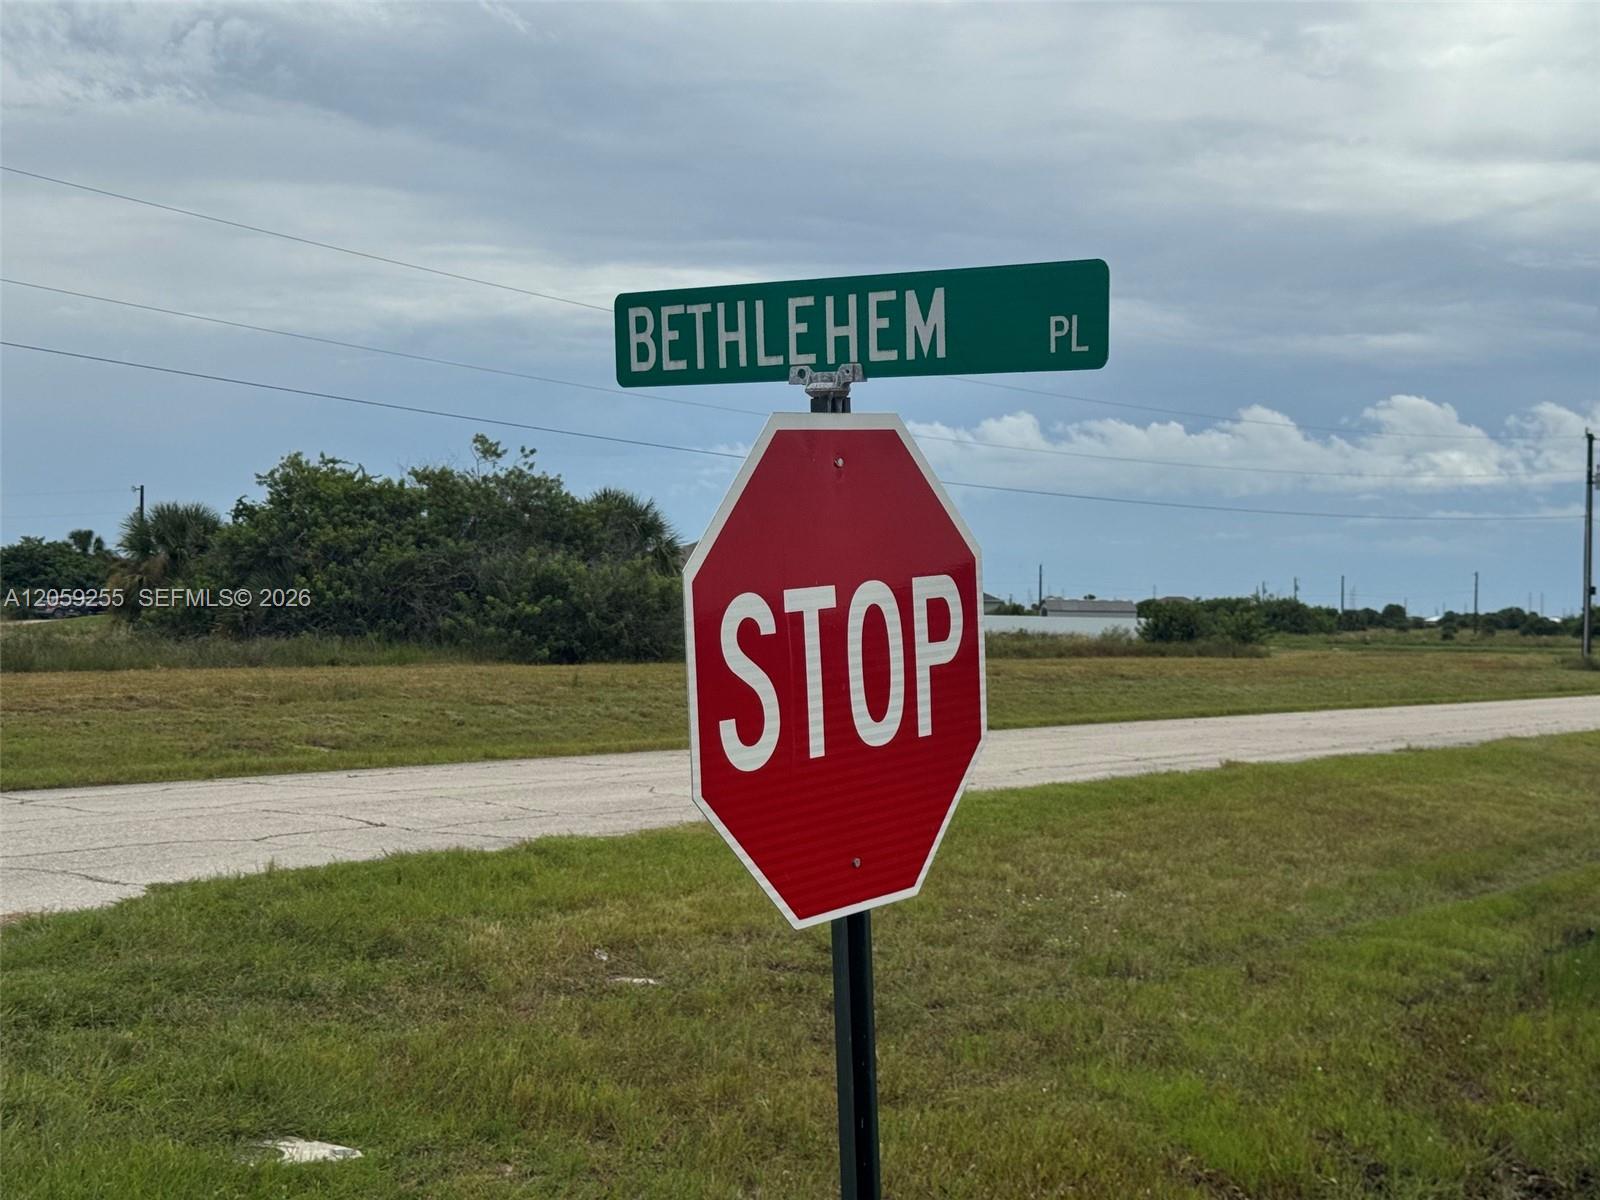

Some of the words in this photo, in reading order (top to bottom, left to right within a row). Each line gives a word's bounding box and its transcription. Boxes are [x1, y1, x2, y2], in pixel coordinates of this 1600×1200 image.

[628, 287, 946, 373] BETHLEHEM
[1049, 315, 1089, 353] PL
[718, 574, 964, 773] STOP
